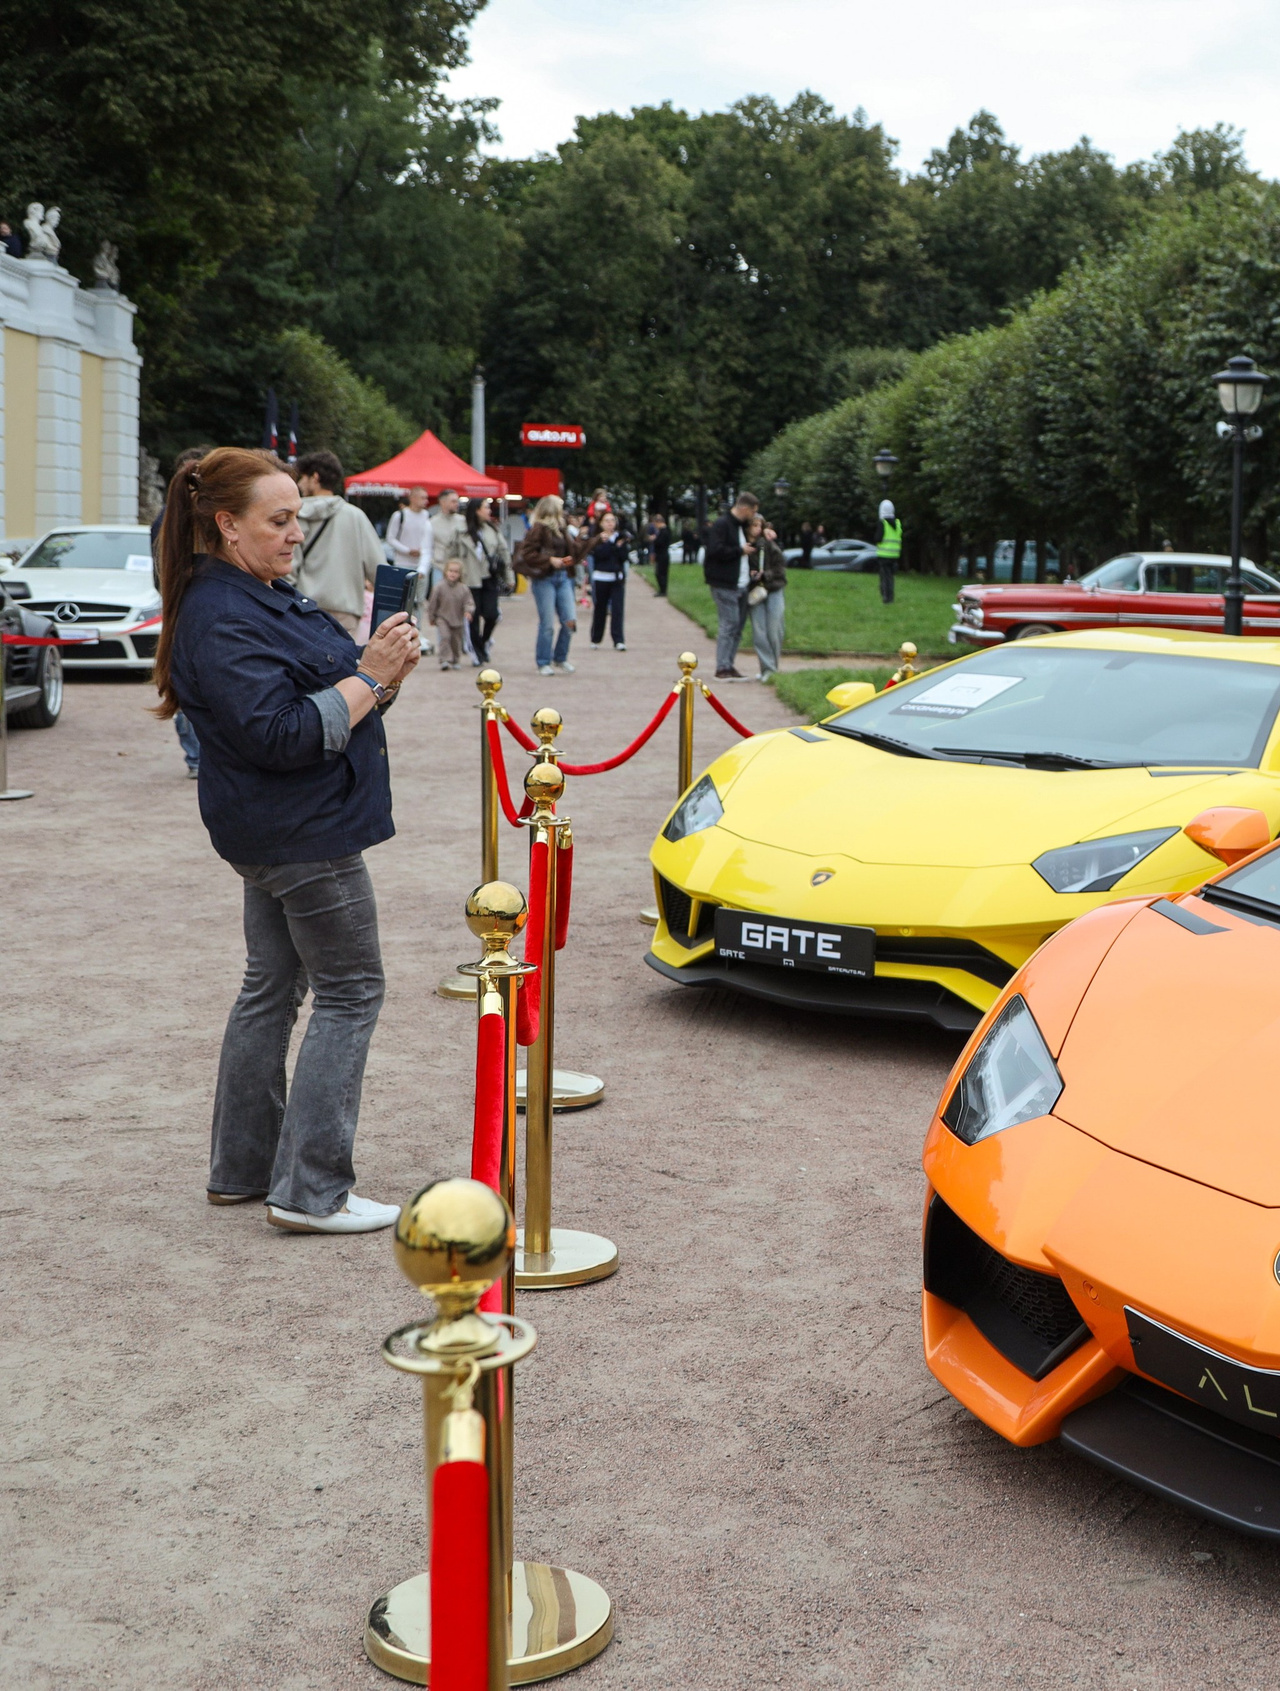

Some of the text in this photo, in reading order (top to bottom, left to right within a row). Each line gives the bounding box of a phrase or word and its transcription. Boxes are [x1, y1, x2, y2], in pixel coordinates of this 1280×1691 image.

[527, 429, 577, 443] auto.ru
[741, 921, 842, 960] GATE
[719, 948, 746, 960] GATE
